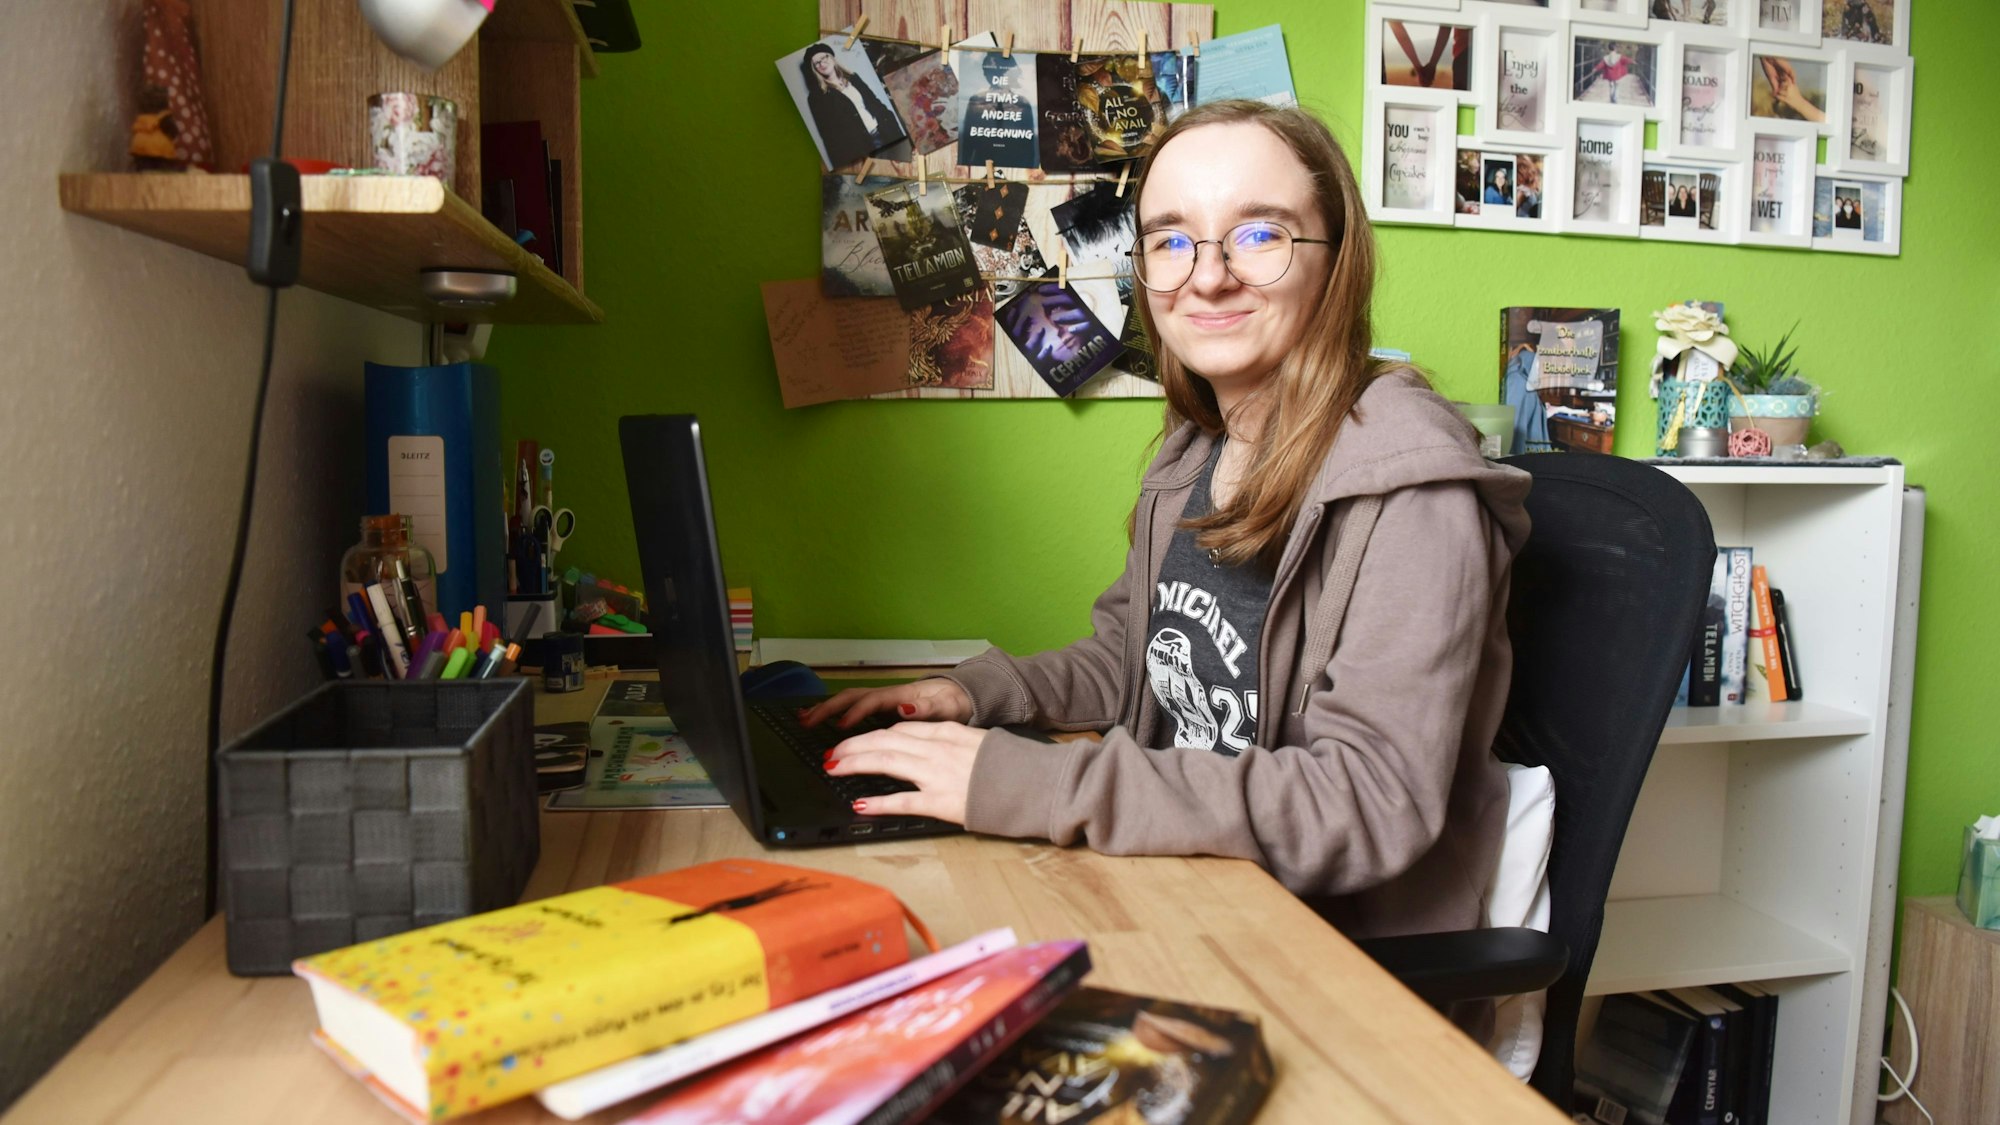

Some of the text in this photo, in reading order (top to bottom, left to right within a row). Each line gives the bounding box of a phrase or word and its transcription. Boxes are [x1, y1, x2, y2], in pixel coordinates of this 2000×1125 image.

[1503, 49, 1539, 79] Enjoy
[991, 75, 1009, 86] DIE
[1510, 83, 1528, 95] the
[985, 92, 1019, 104] ETWAS
[1105, 95, 1124, 109] ALL
[981, 109, 1023, 123] ANDERE
[1116, 106, 1138, 119] NO
[1114, 118, 1147, 132] AVAIL
[1387, 123, 1409, 139] YOU
[970, 126, 1034, 141] BEGEGNUNG
[1578, 136, 1614, 155] home
[1757, 200, 1783, 219] WET
[893, 246, 967, 284] TELAMON
[1556, 327, 1576, 339] Die
[1049, 334, 1108, 383] CEPHYAR
[1543, 361, 1592, 376] Bibliothek
[406, 452, 430, 460] LEITZ
[1731, 551, 1747, 635] WITCHGHOST
[1703, 623, 1718, 682] TELAMON
[1727, 652, 1735, 674] LYNN
[1735, 650, 1744, 676] RAVEN
[1704, 1068, 1718, 1111] CEPHYAR
